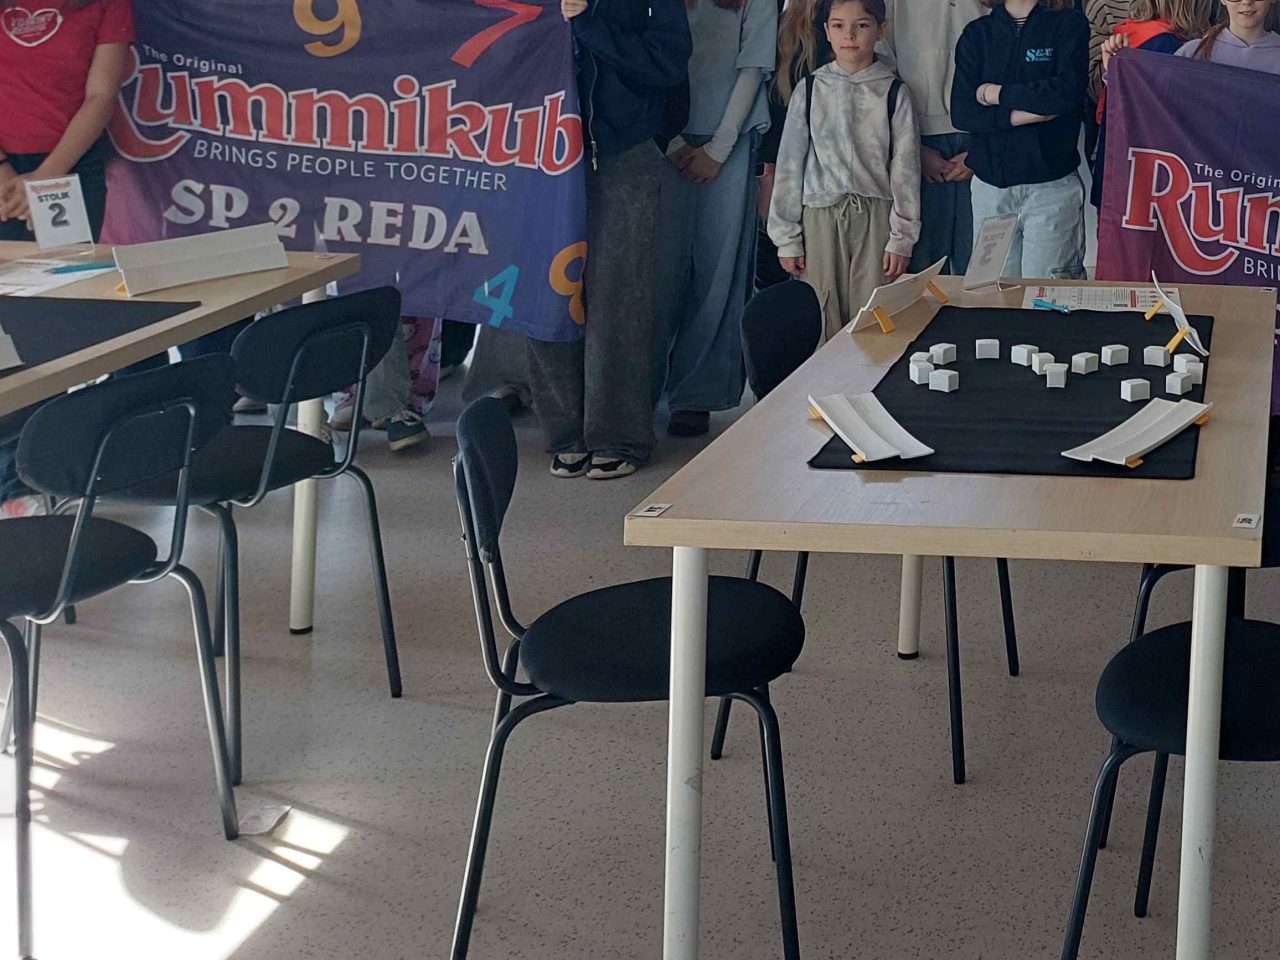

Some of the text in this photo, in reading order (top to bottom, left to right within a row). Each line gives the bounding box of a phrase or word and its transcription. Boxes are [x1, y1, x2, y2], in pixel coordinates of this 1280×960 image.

[143, 44, 243, 75] The Original
[193, 139, 507, 191] BRINGS PEOPLE TOGETHER
[1194, 162, 1224, 179] The
[48, 203, 71, 228] 2
[163, 178, 490, 256] SP 2 REDA
[473, 264, 520, 327] 4
